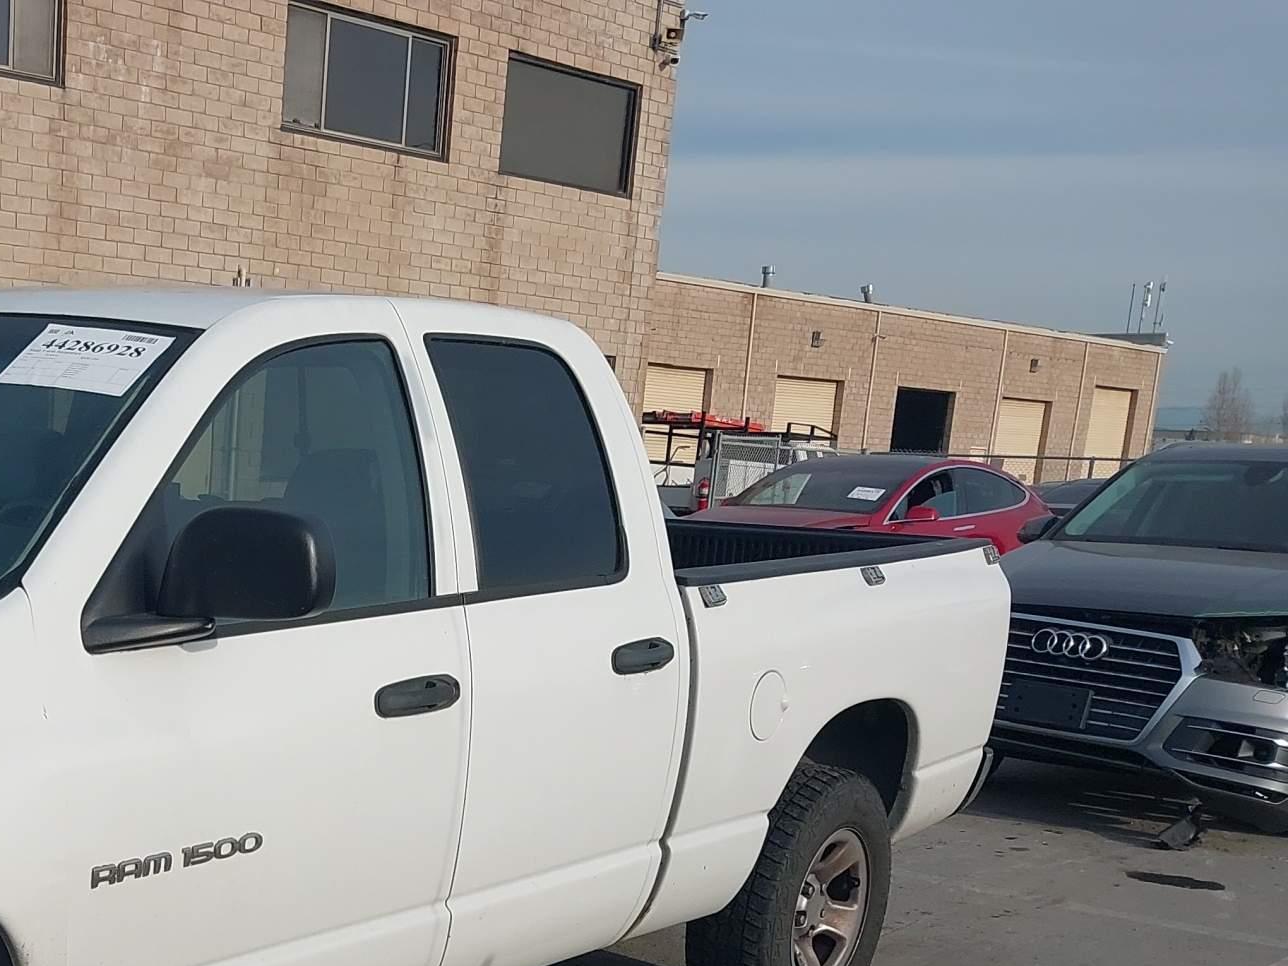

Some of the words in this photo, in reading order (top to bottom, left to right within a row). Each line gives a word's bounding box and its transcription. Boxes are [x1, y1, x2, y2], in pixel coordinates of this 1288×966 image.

[42, 338, 146, 358] 44286928
[90, 851, 173, 890] RAM
[181, 831, 263, 868] 1500
